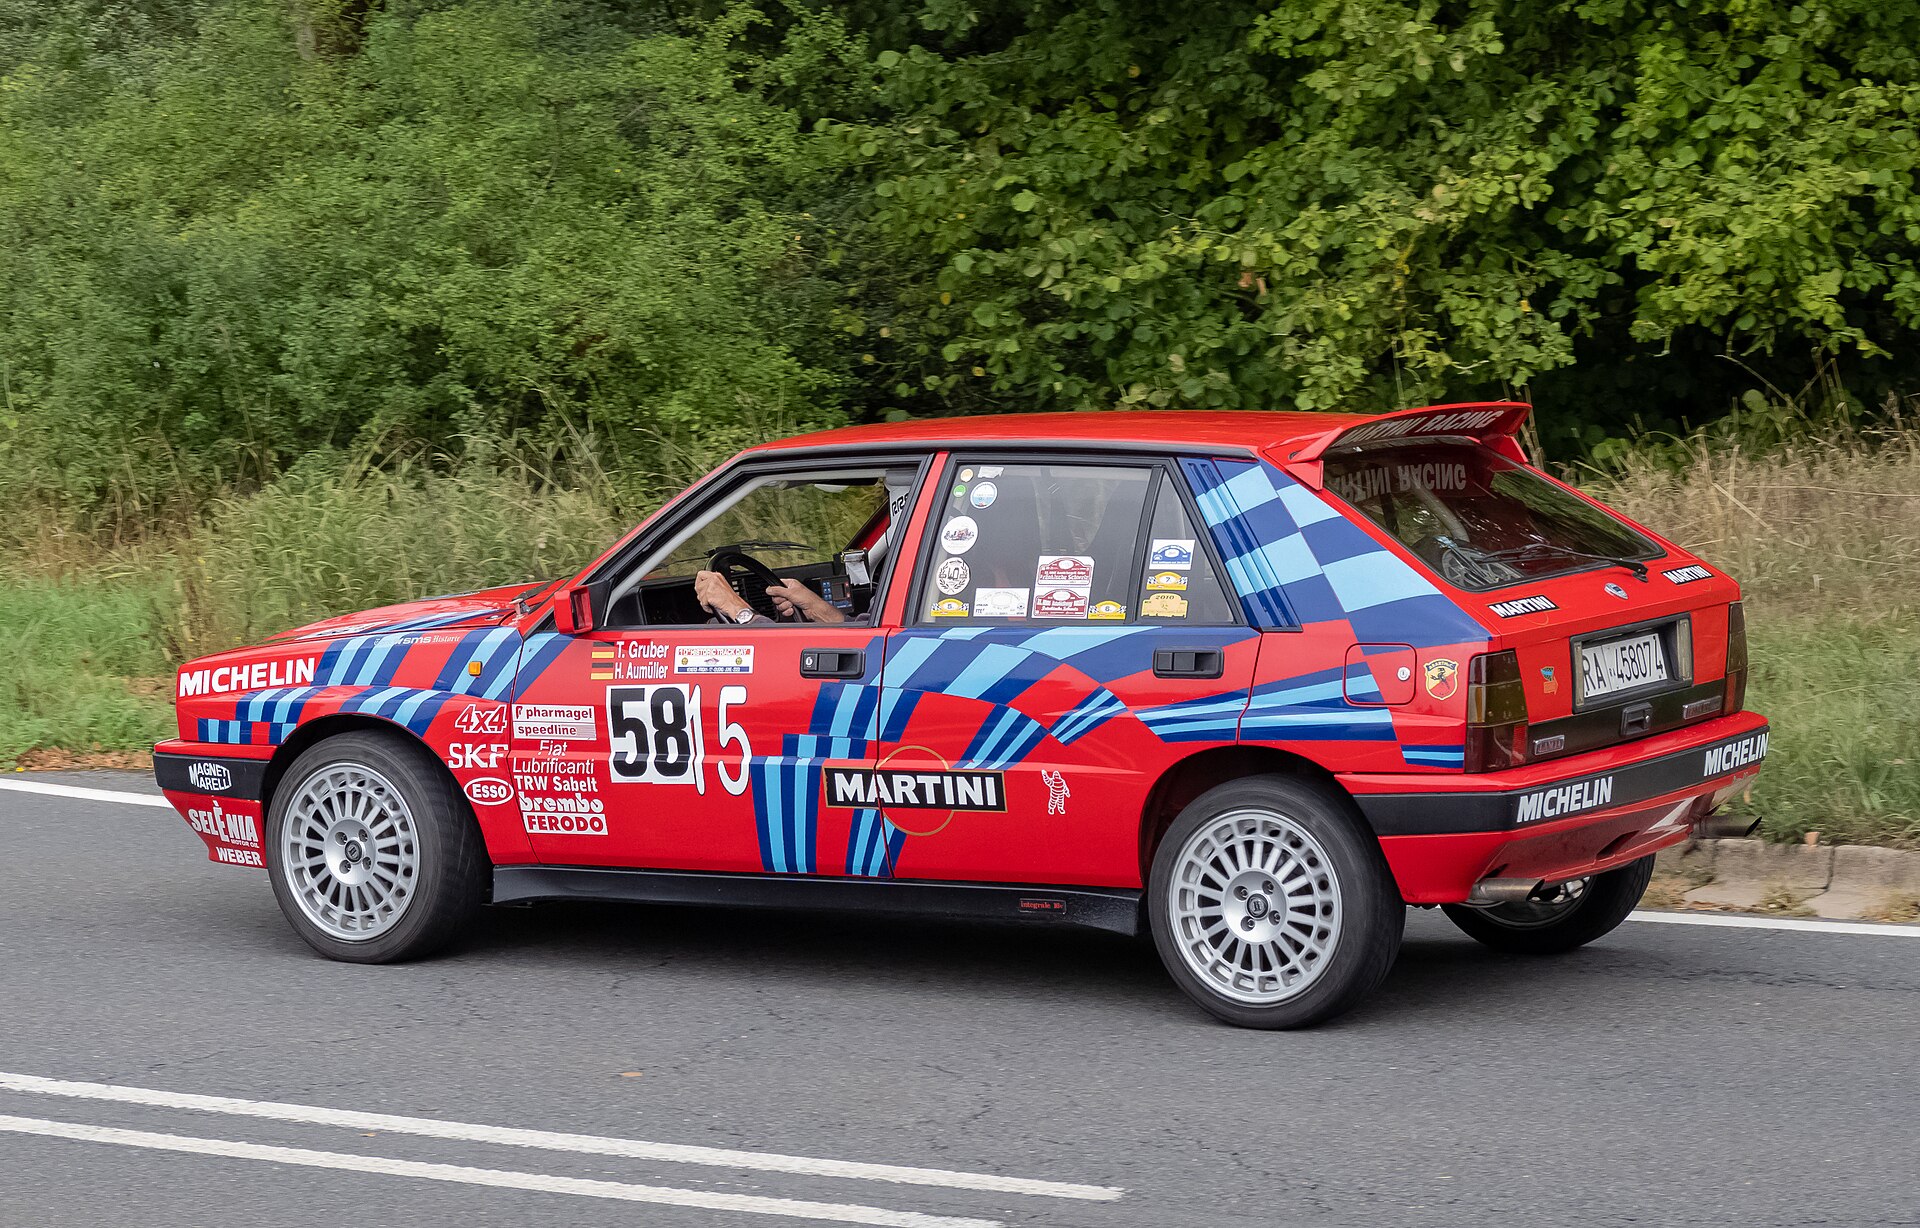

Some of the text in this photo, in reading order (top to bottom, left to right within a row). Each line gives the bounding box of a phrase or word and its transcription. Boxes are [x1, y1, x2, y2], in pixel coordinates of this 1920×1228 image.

[1415, 410, 1504, 433] RACING
[1663, 565, 1712, 584] MARTINI
[1488, 595, 1556, 618] MARTINI
[616, 641, 669, 659] T. Gruber
[614, 662, 624, 679] H.
[626, 662, 669, 679] Aumüller
[1582, 635, 1664, 692] RA 458074
[179, 657, 315, 697] MICHELIN
[455, 704, 507, 734] 4x4
[526, 706, 592, 720] pharmagel
[518, 725, 577, 736] speedline
[611, 687, 690, 777] 58
[448, 743, 508, 768] SKF
[538, 740, 567, 756] Fiat
[1704, 732, 1769, 776] MICHELIN
[513, 757, 594, 774] Lubrificanti
[514, 776, 598, 792] TRW Sabelt
[834, 773, 997, 807] MARTINI
[519, 791, 604, 813] brembo
[1517, 776, 1613, 823] MICHELIN
[527, 815, 603, 832] FERODO
[216, 846, 263, 866] WEBER
